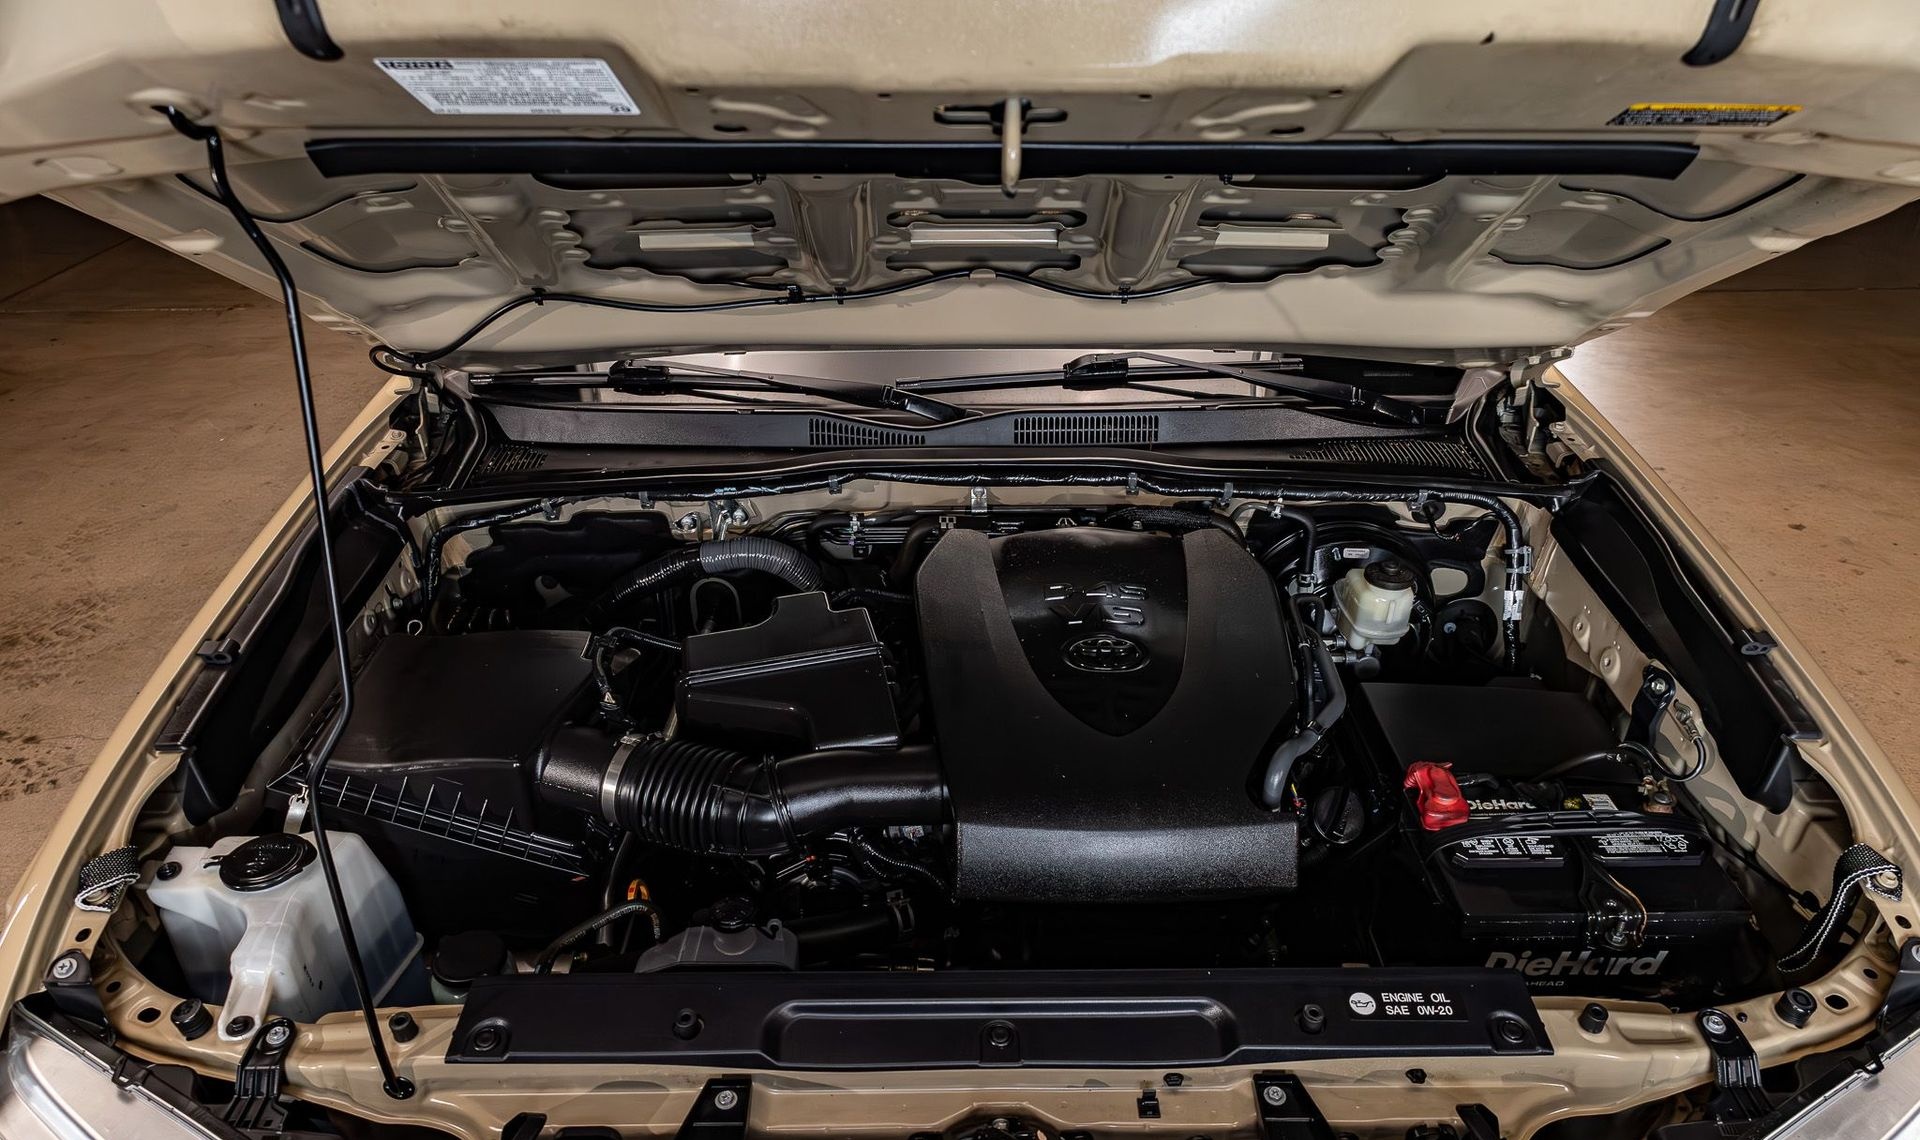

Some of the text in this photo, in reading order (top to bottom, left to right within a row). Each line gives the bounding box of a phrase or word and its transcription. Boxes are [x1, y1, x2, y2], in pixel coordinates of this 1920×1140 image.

[1381, 992, 1451, 1003] ENGINE OIL
[1386, 1005, 1453, 1016] SAE 0W-20
